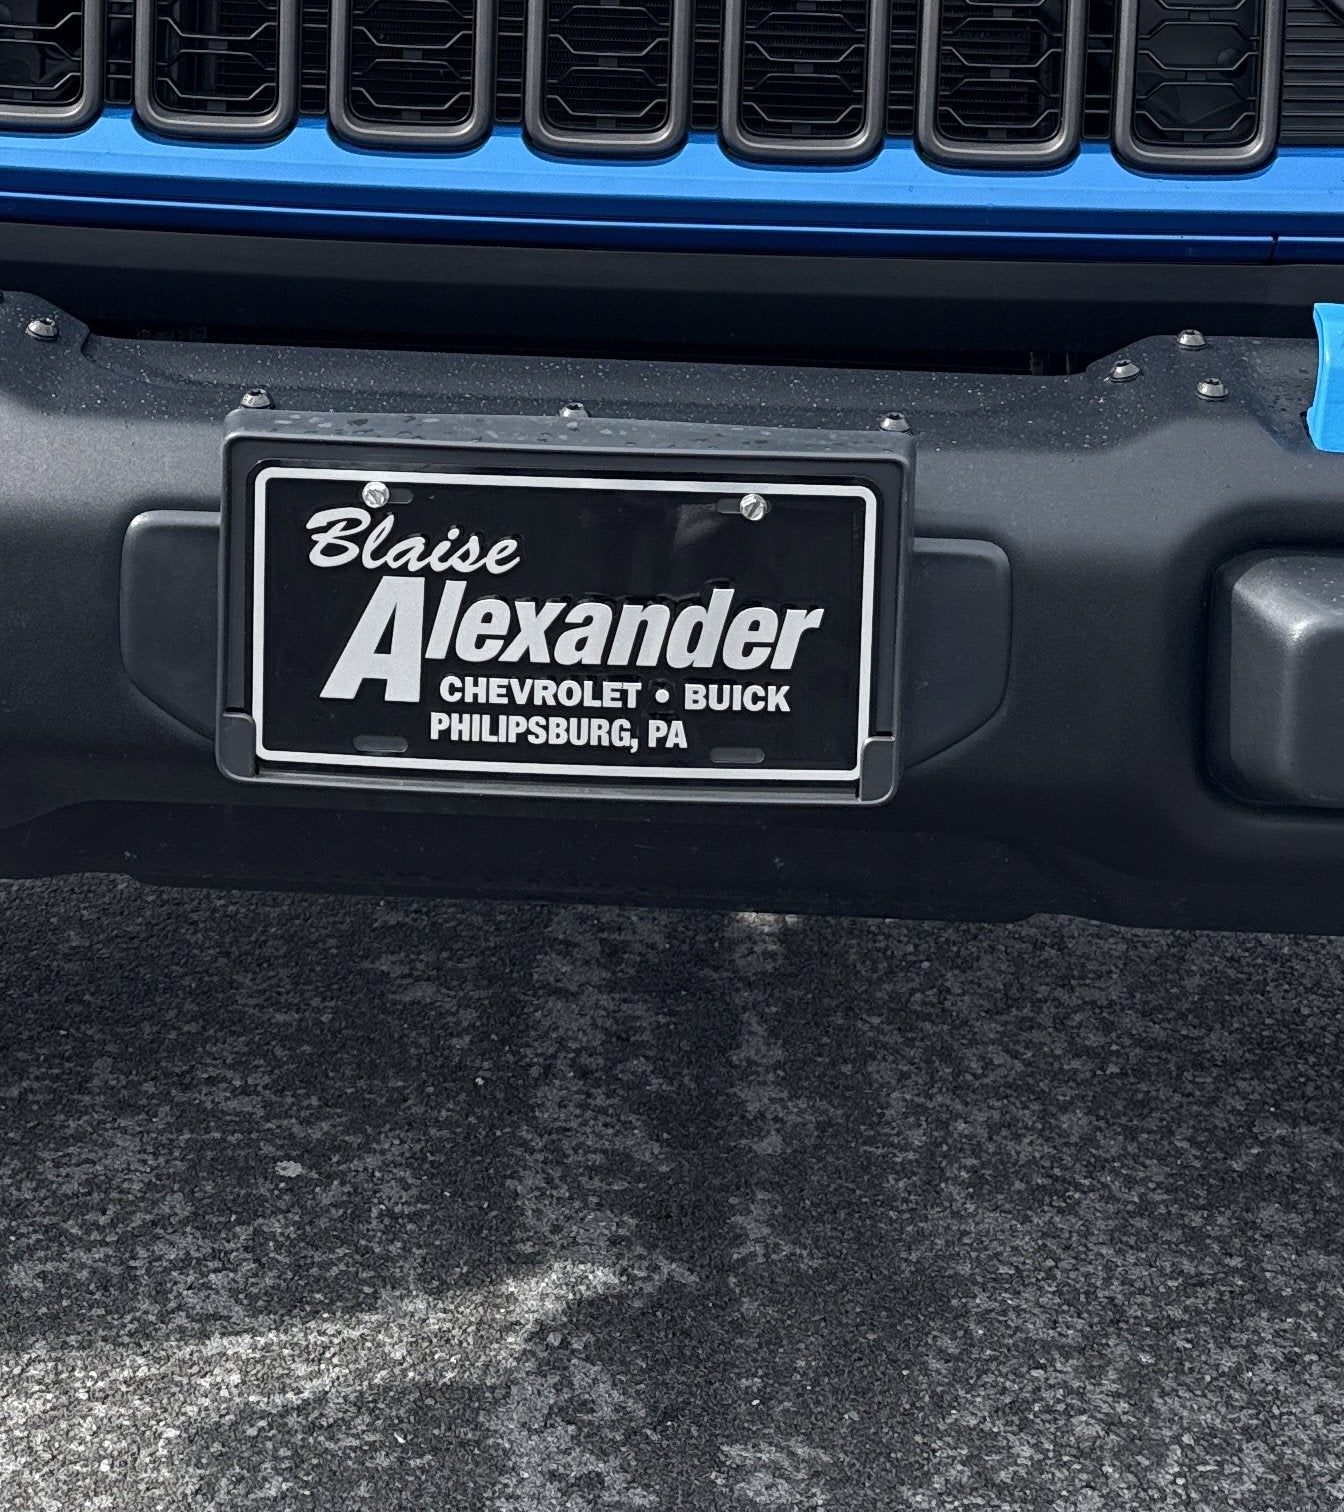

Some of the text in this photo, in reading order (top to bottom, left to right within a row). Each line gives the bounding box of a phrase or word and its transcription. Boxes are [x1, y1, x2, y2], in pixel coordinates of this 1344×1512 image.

[305, 507, 521, 575] Blaise
[319, 575, 825, 703] Alexander
[439, 675, 791, 712] CHEVROLET BUICK
[429, 711, 688, 754] PHILIPSBURG, PA
